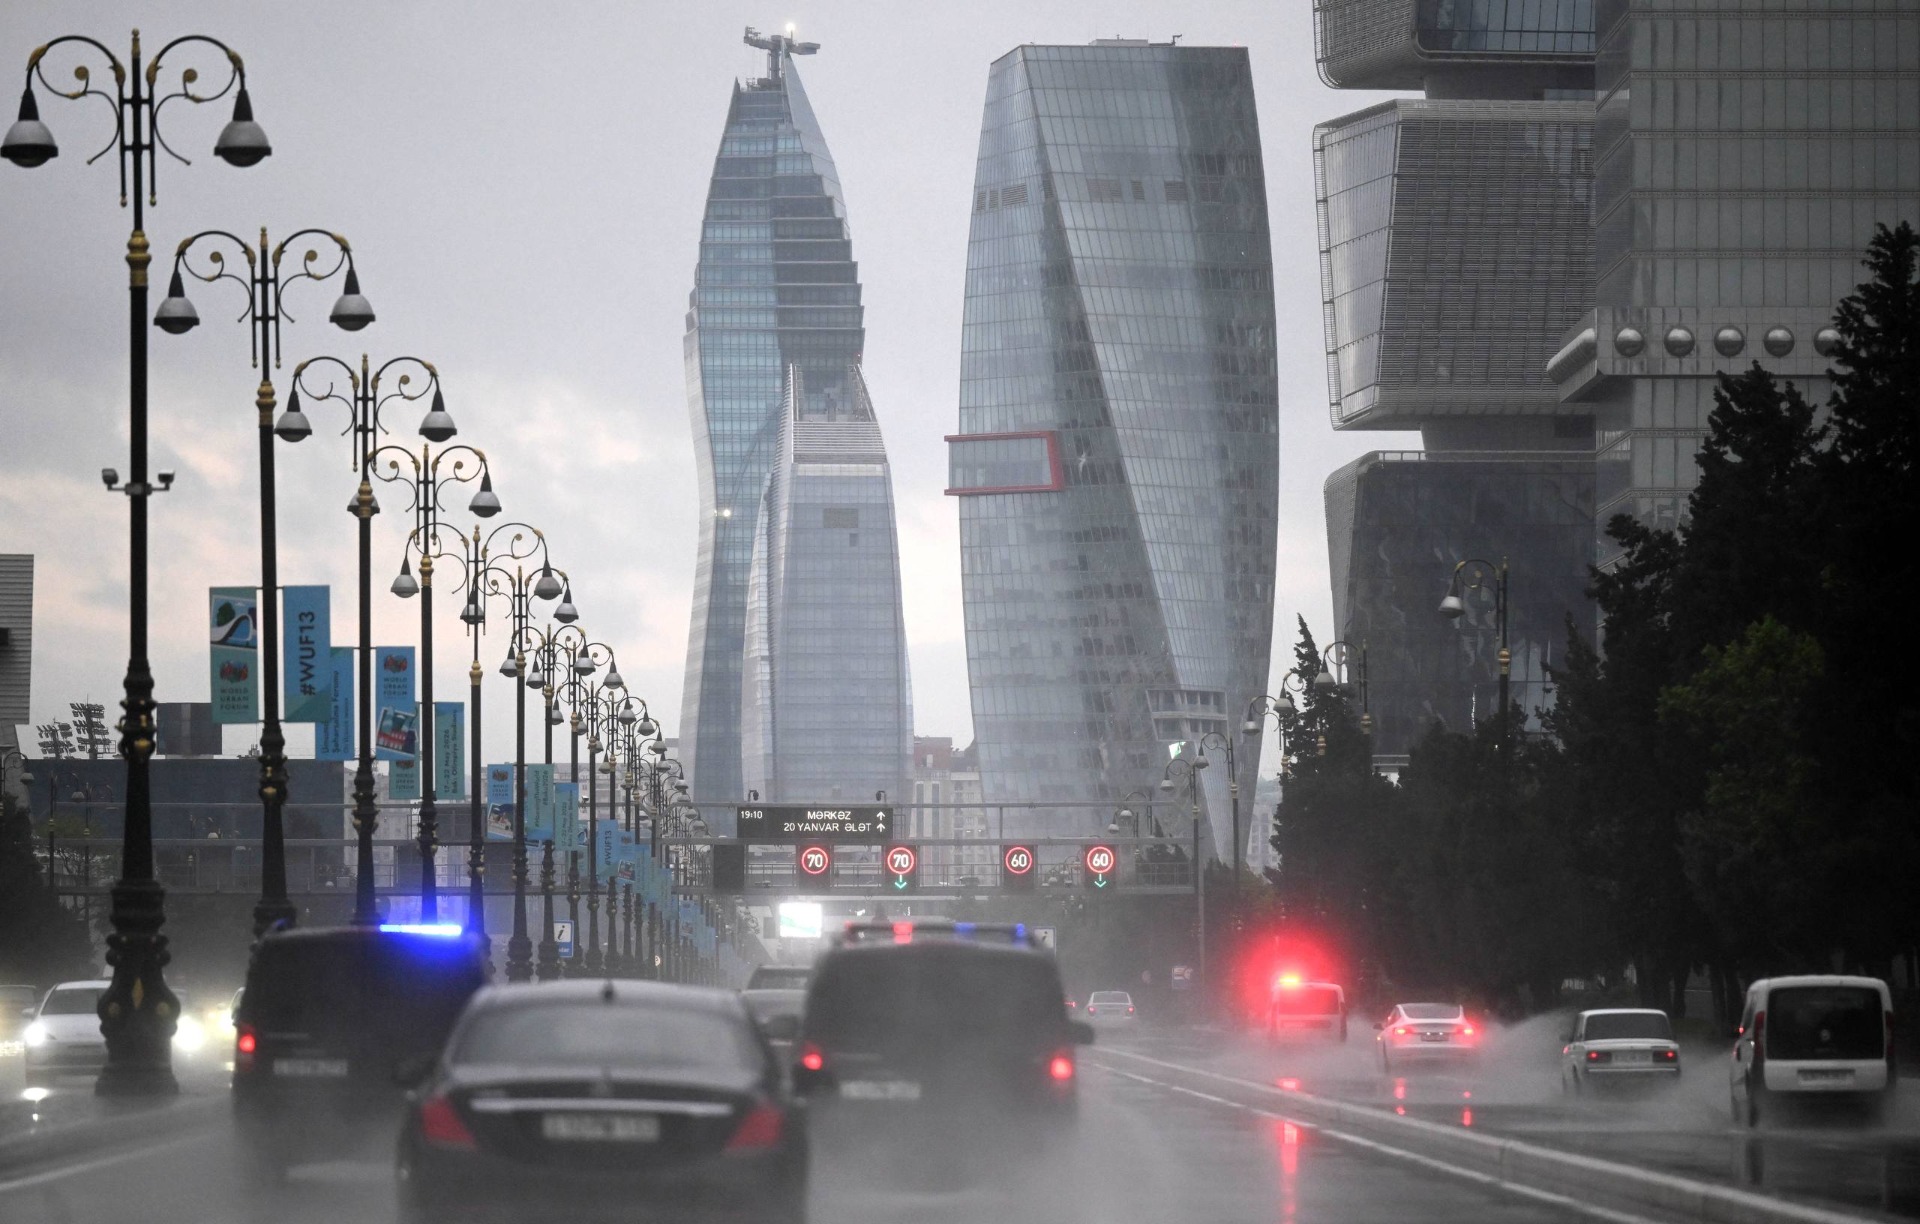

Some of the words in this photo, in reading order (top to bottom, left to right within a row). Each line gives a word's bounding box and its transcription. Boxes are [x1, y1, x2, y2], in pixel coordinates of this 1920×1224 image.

[298, 610, 316, 696] #WUF13
[740, 810, 763, 820] 19:10
[807, 810, 852, 821] MƏRKƏZ
[783, 822, 796, 832] 20
[797, 822, 840, 832] YANVAR
[844, 822, 872, 832] ƏLƏT
[806, 853, 824, 868] 70
[892, 853, 910, 868] 70
[1010, 853, 1028, 868] 60
[1092, 852, 1109, 867] 60
